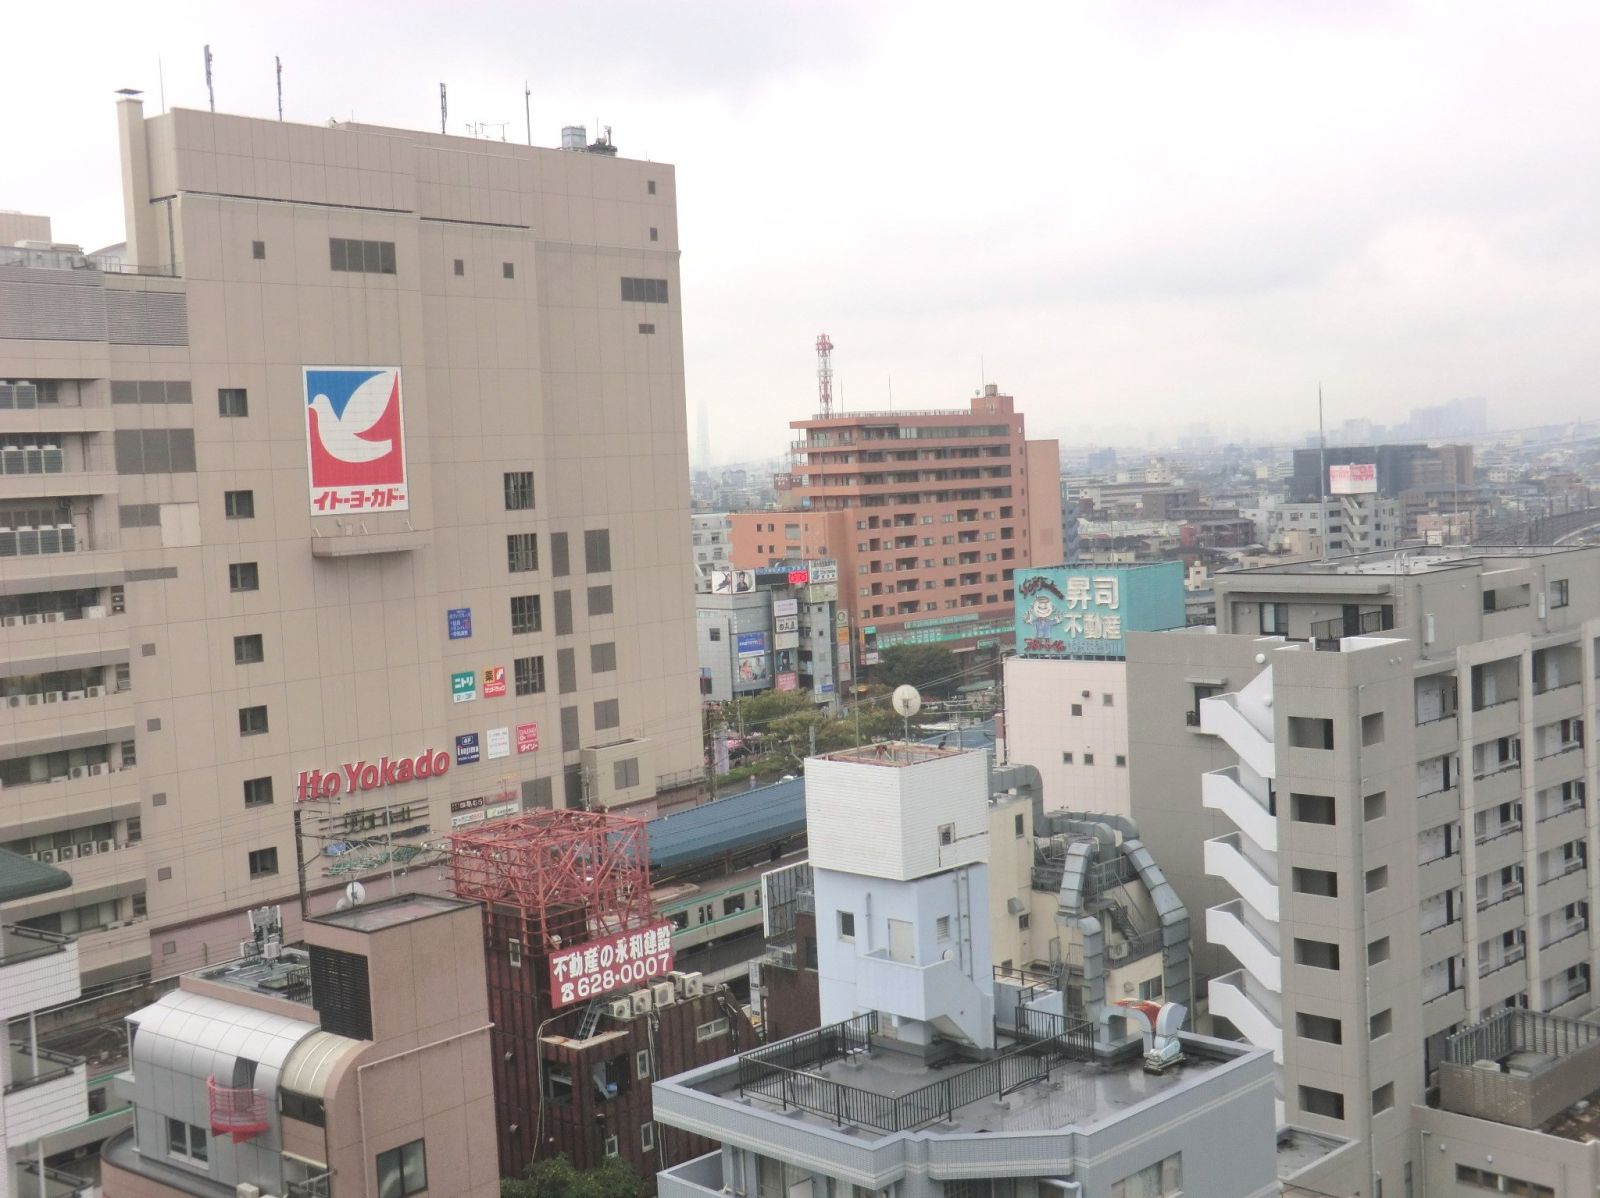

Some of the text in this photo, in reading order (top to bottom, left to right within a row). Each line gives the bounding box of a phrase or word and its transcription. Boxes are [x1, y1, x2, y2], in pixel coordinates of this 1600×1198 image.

[313, 488, 405, 511] イトーヨーカドー
[1066, 576, 1119, 610] 昇司
[1063, 612, 1122, 640] 不動産
[454, 676, 474, 689] ニトリ
[520, 743, 538, 753] ダイソー
[296, 748, 450, 802] Ito Yokado
[553, 925, 671, 982] 不動産の永和建設
